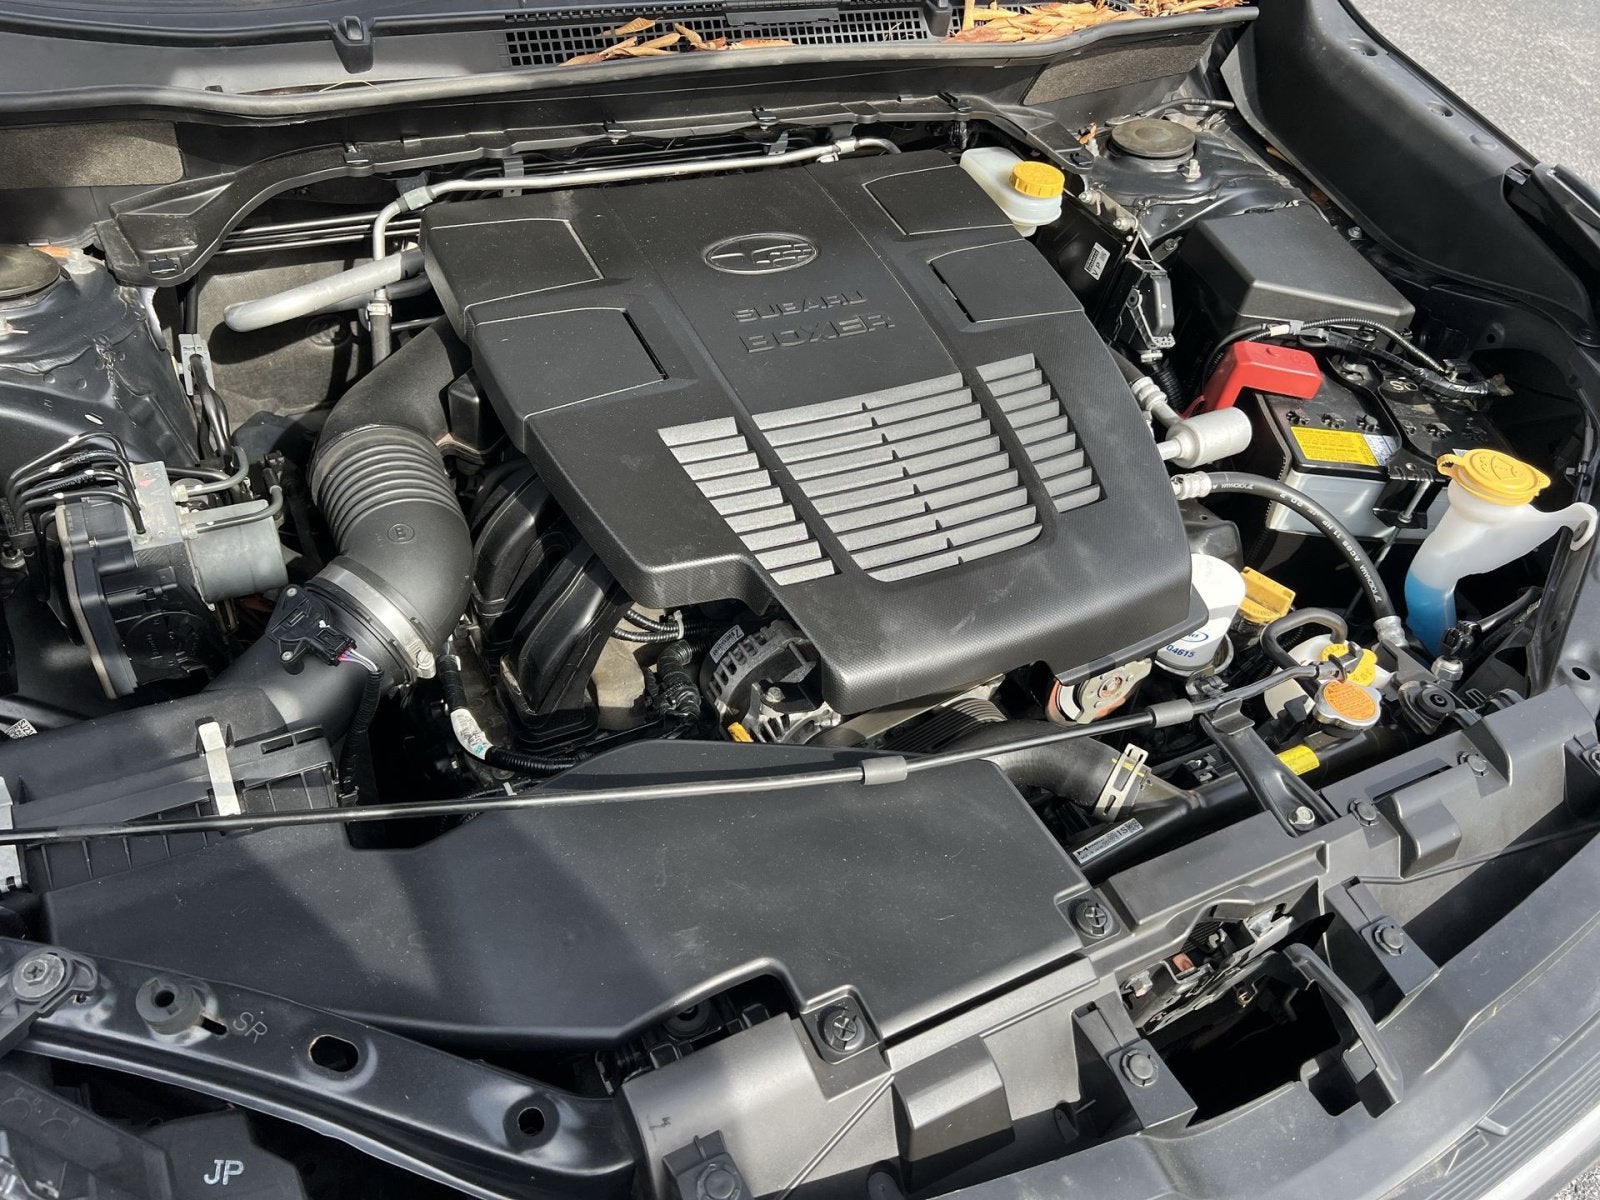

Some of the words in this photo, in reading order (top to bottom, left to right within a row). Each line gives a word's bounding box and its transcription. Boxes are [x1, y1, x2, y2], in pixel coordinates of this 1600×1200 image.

[731, 290, 868, 323] SUBARU
[739, 314, 896, 353] BOXER
[232, 1011, 268, 1045] SR
[203, 1159, 244, 1186] JP
